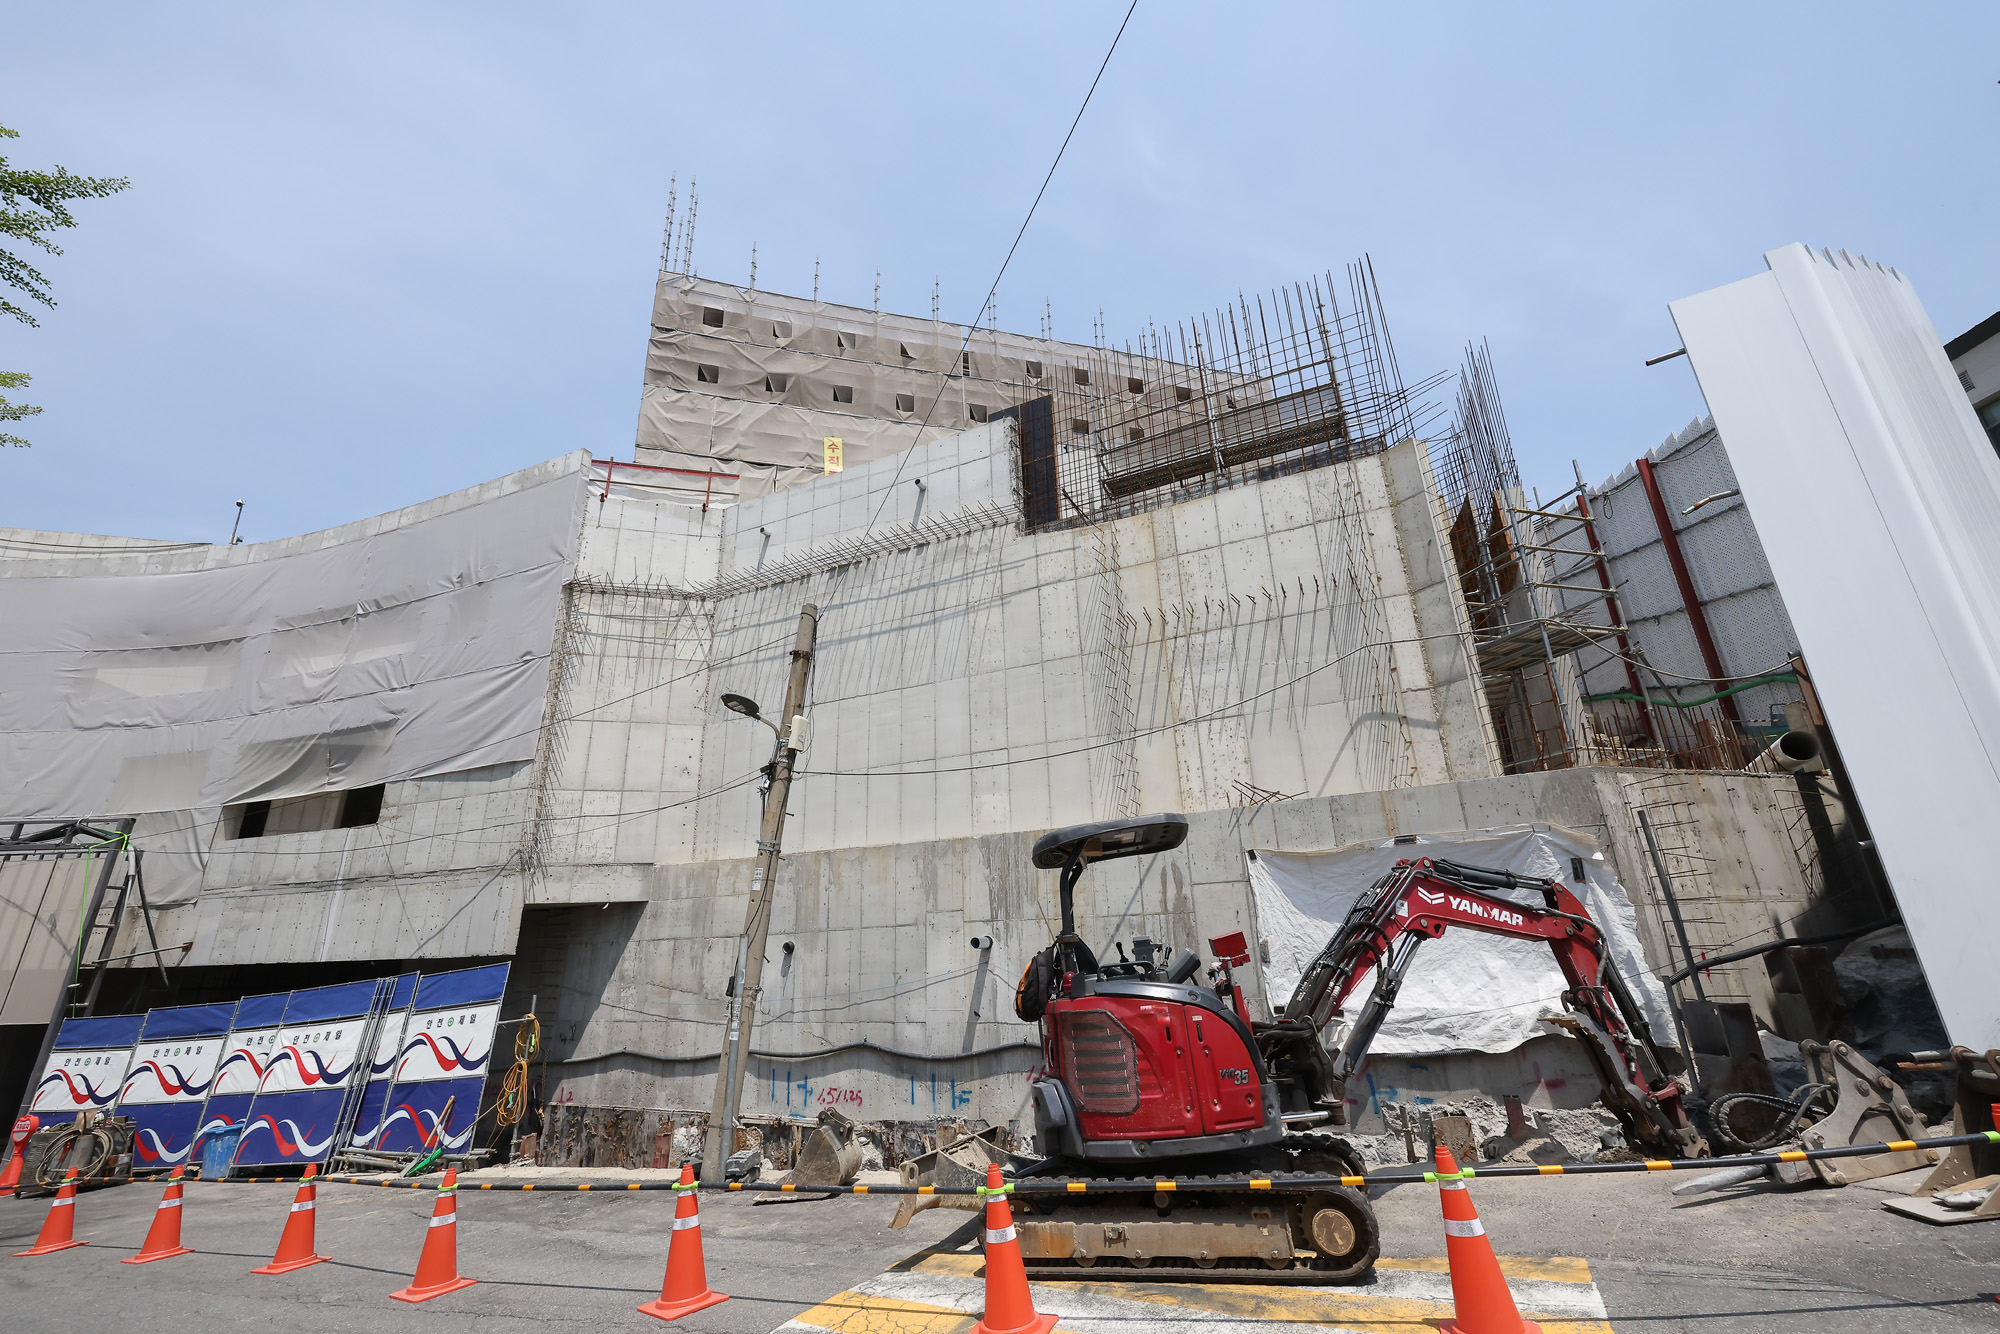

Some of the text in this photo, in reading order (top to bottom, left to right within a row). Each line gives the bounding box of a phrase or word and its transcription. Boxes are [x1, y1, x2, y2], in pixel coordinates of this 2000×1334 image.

[1448, 895, 1524, 926] YANMAR
[426, 1013, 477, 1030] 안전 제일
[246, 1035, 264, 1046] 안전
[292, 1029, 343, 1045] 안전 제일
[152, 1045, 203, 1058] 안전 제일
[63, 1056, 112, 1067] 안전 제일
